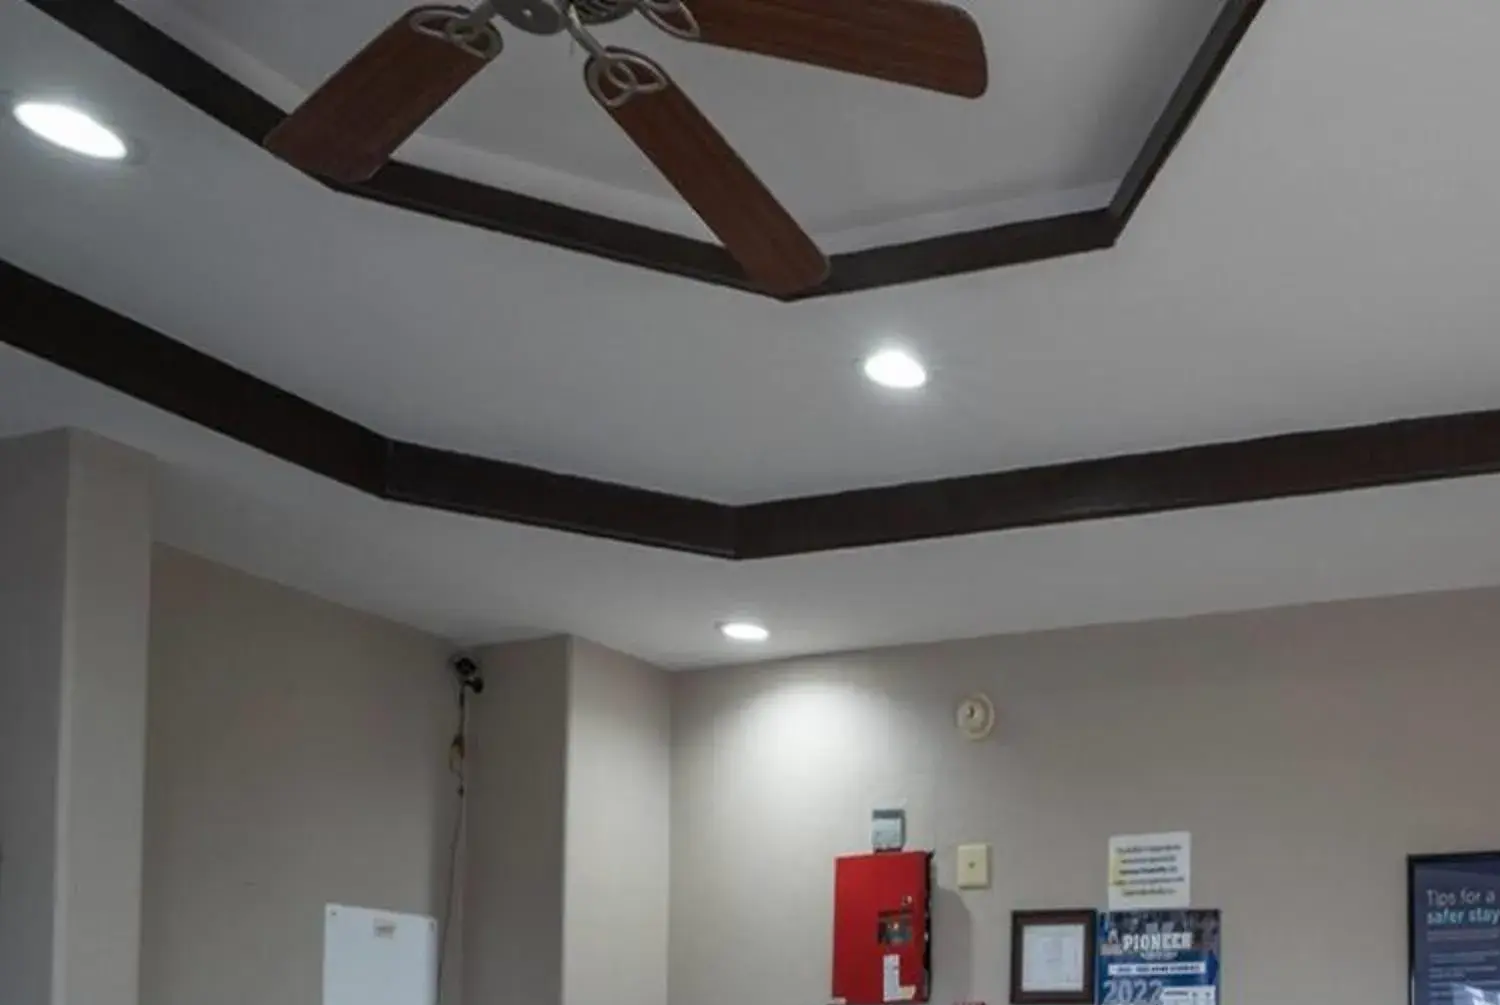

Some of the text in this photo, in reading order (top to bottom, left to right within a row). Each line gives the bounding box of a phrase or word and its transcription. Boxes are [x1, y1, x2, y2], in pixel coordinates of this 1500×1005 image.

[1426, 886, 1496, 909] Tips for a
[1426, 907, 1500, 926] safer stay
[1103, 979, 1163, 1005] 2022
